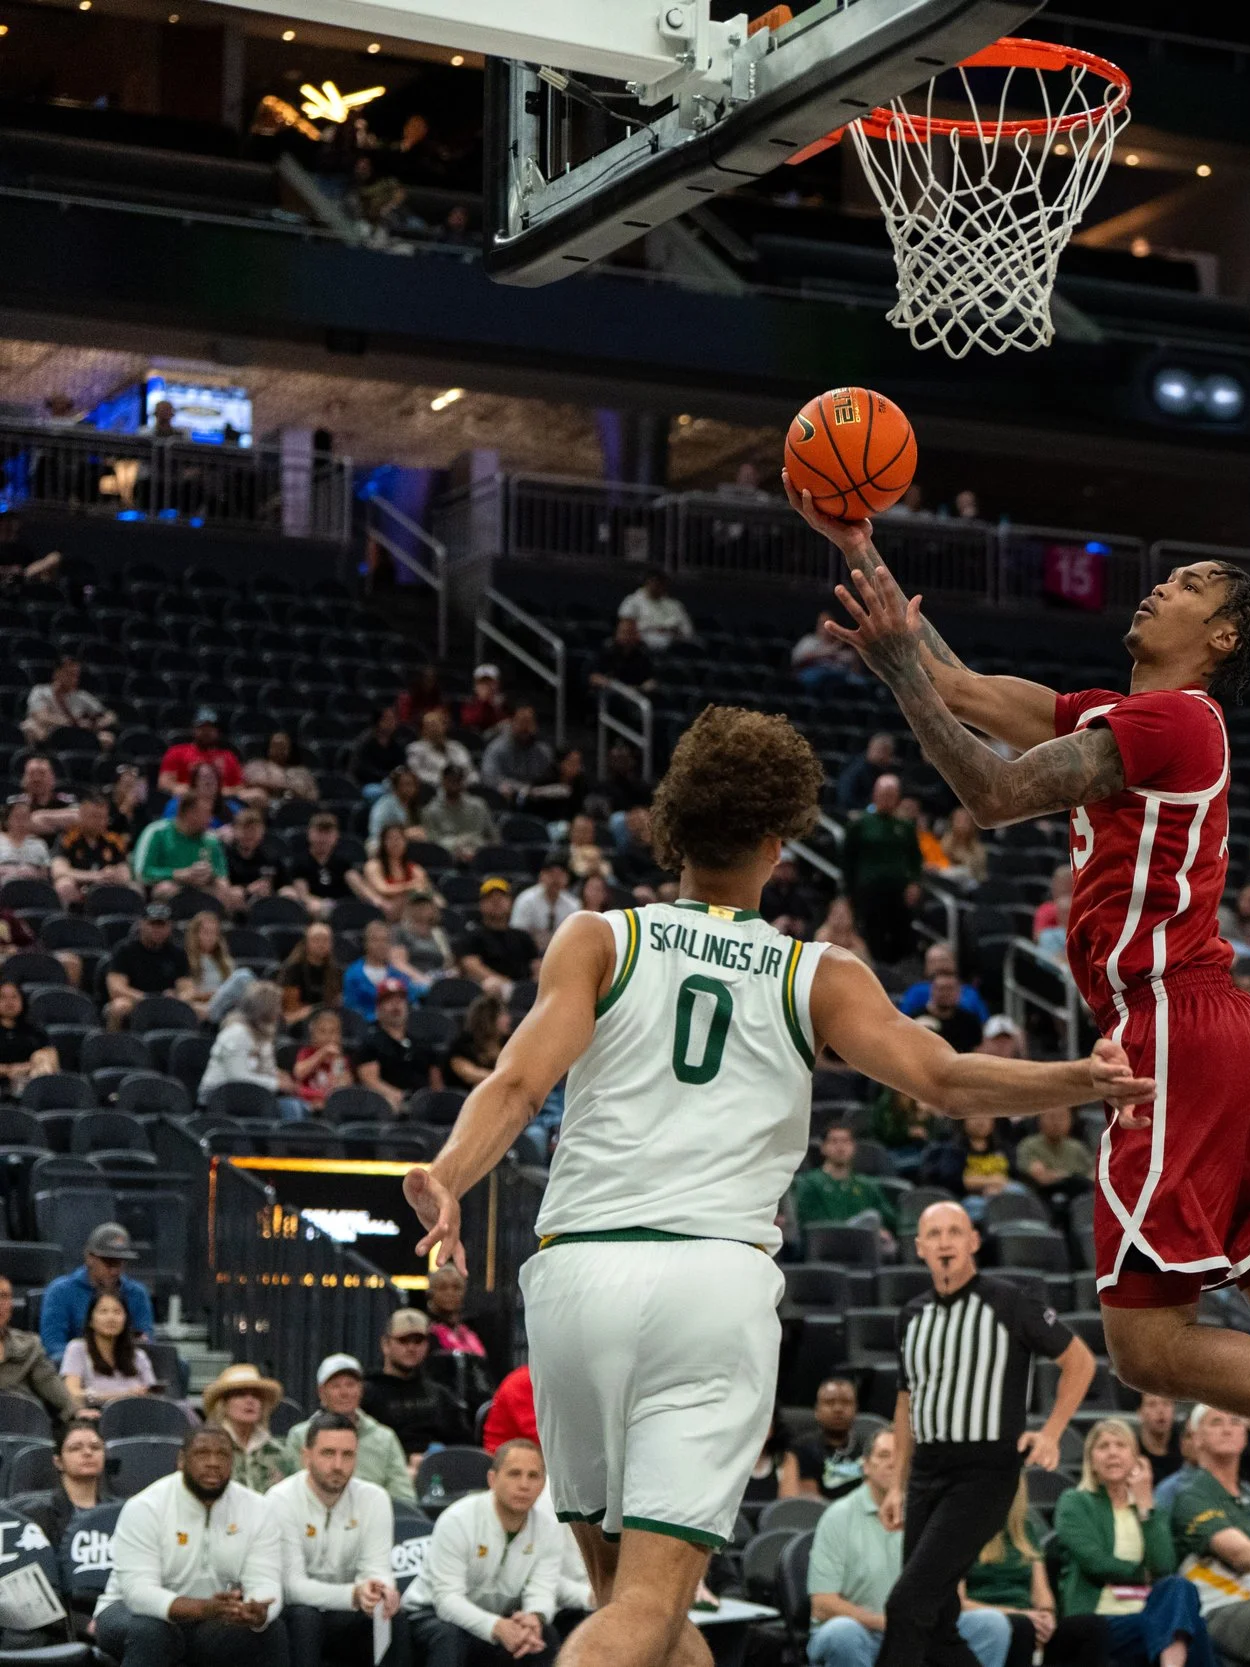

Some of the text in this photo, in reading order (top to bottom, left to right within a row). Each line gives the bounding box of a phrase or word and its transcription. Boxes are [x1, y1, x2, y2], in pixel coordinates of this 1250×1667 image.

[1057, 553, 1092, 595] 15
[650, 922, 782, 978] SKILLINGS JR
[672, 974, 733, 1085] 0
